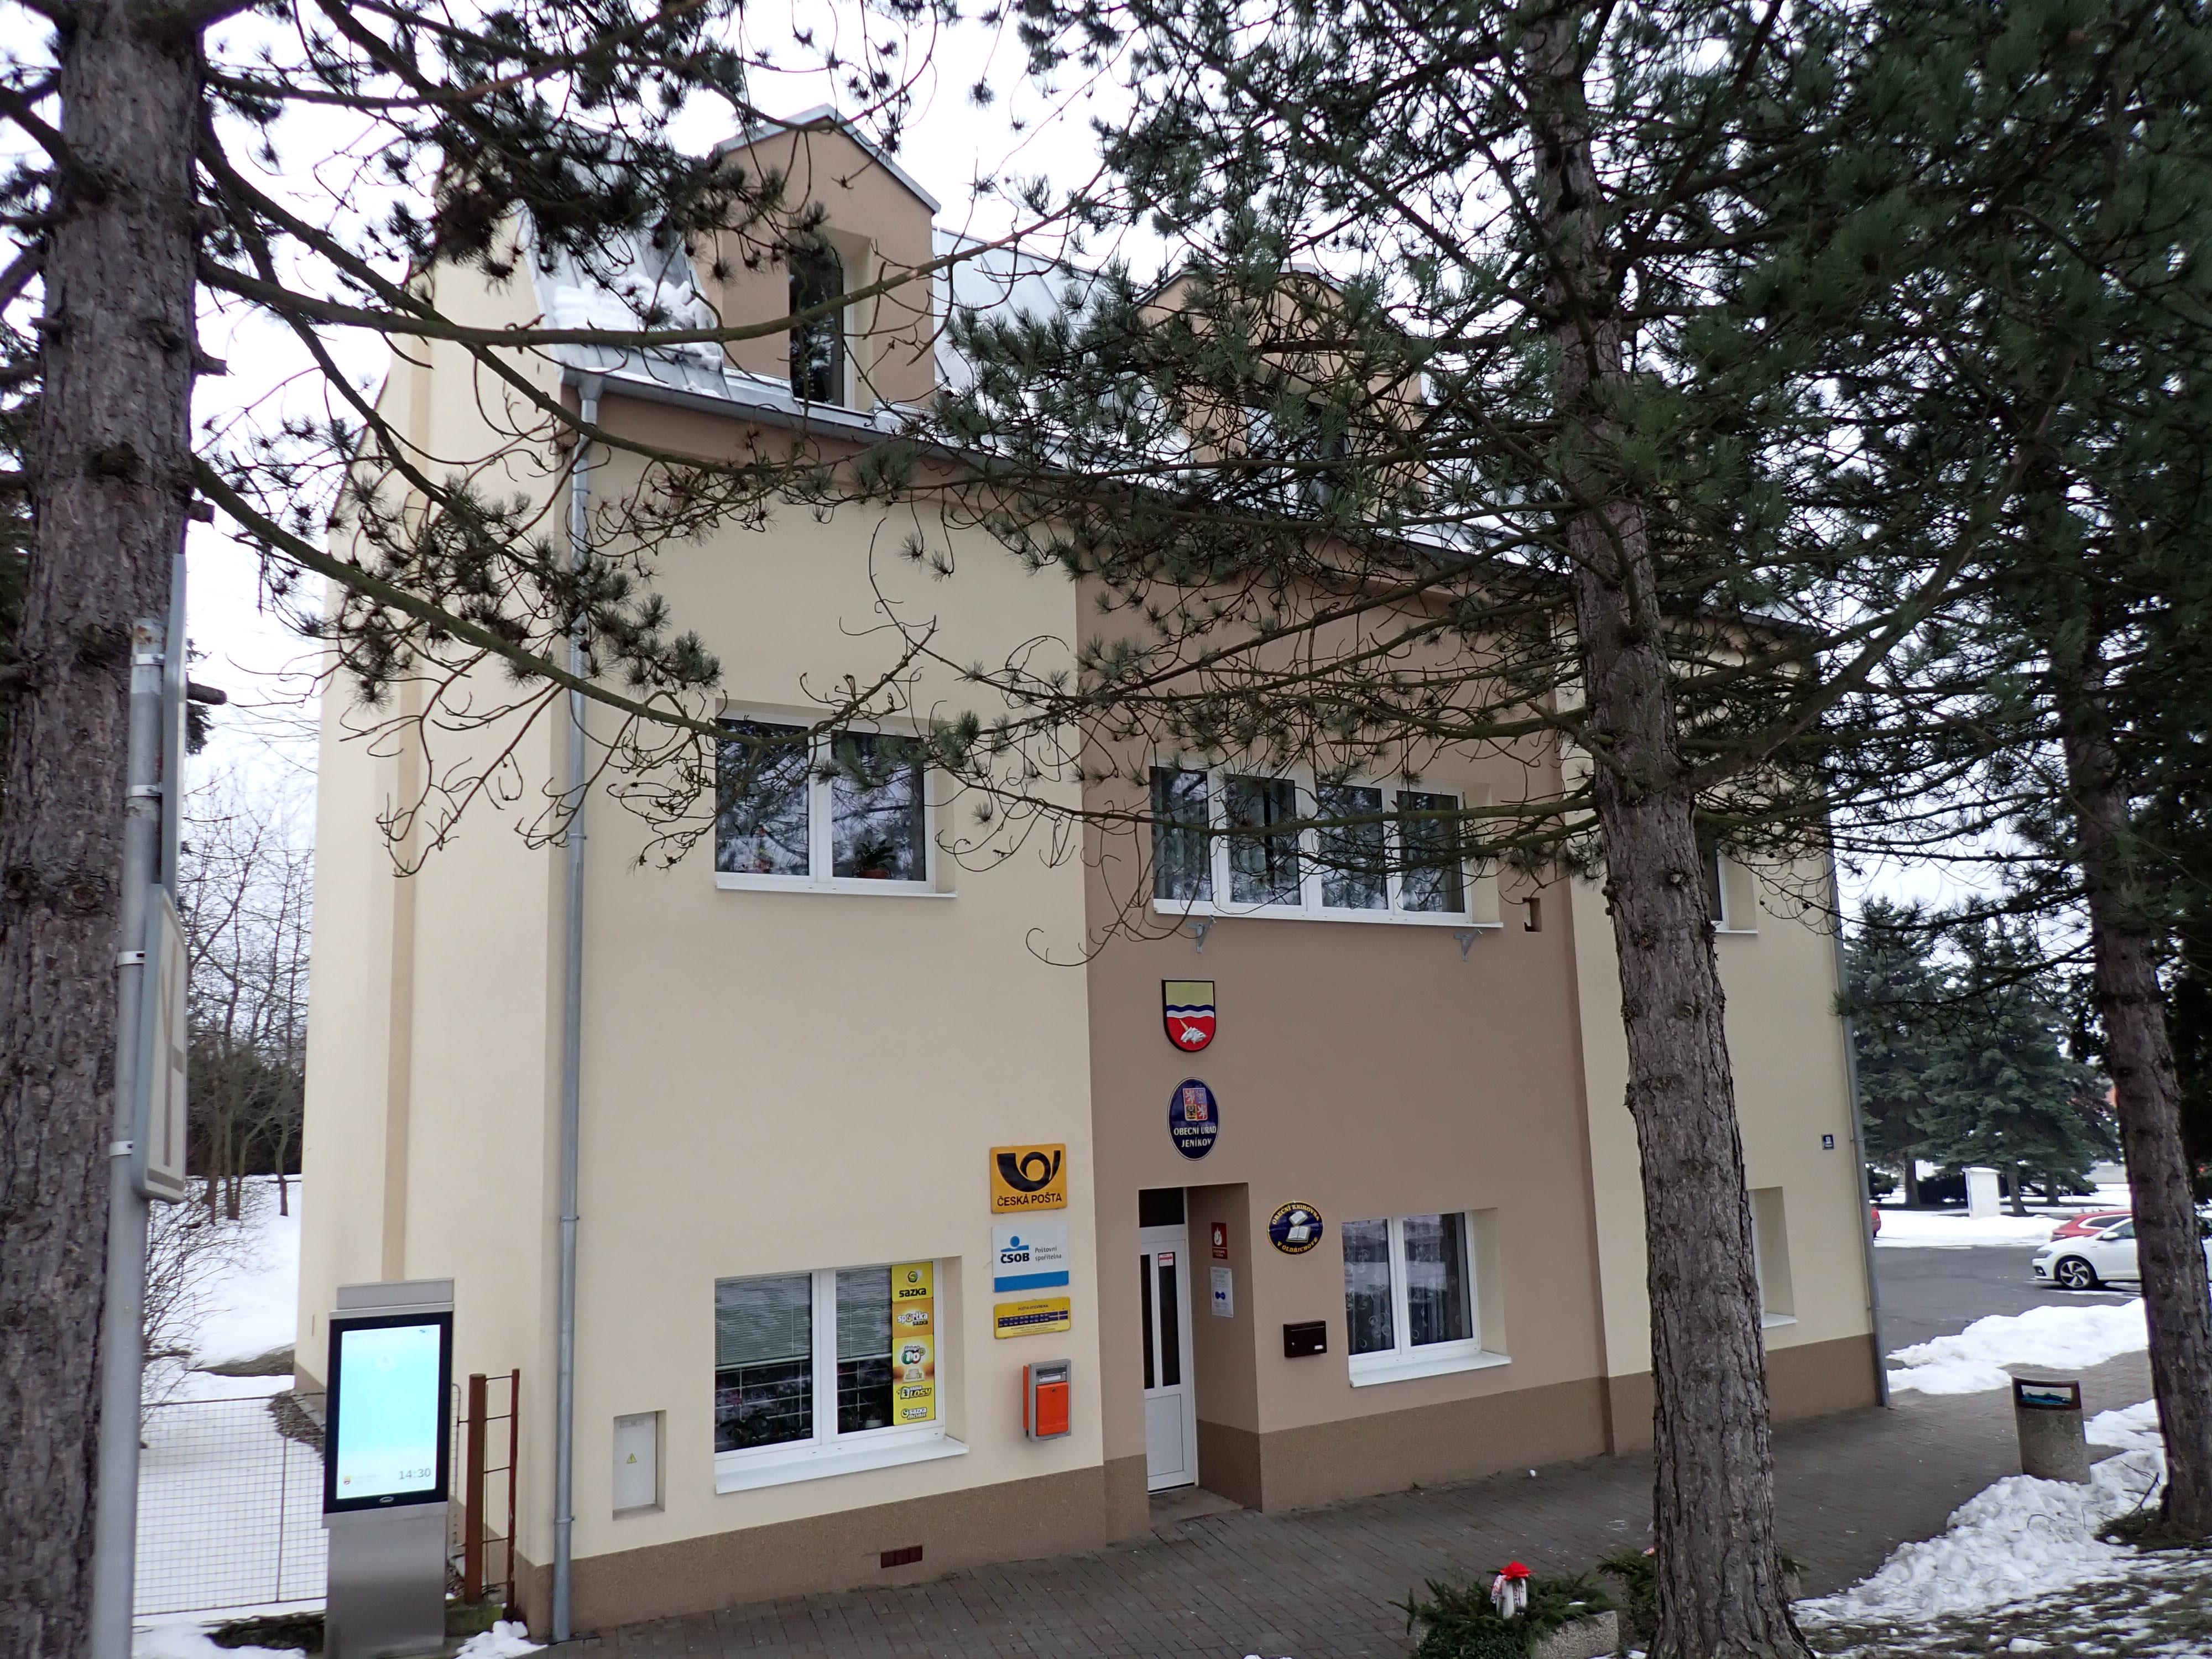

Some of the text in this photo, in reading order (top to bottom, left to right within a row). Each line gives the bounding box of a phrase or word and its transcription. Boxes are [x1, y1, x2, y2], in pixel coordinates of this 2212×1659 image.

[1173, 1124, 1199, 1135] OBECNÍ
[1181, 1137, 1212, 1147] JENÍKOV
[997, 1192, 1062, 1206] ČESKÁ POŠTA
[1291, 1204, 1319, 1221] KNIHOVNA
[1000, 1253, 1030, 1264] ČSOB
[1035, 1254, 1062, 1262] spořitelna
[898, 1311, 928, 1324] sportka
[398, 1468, 431, 1480] 14:30
